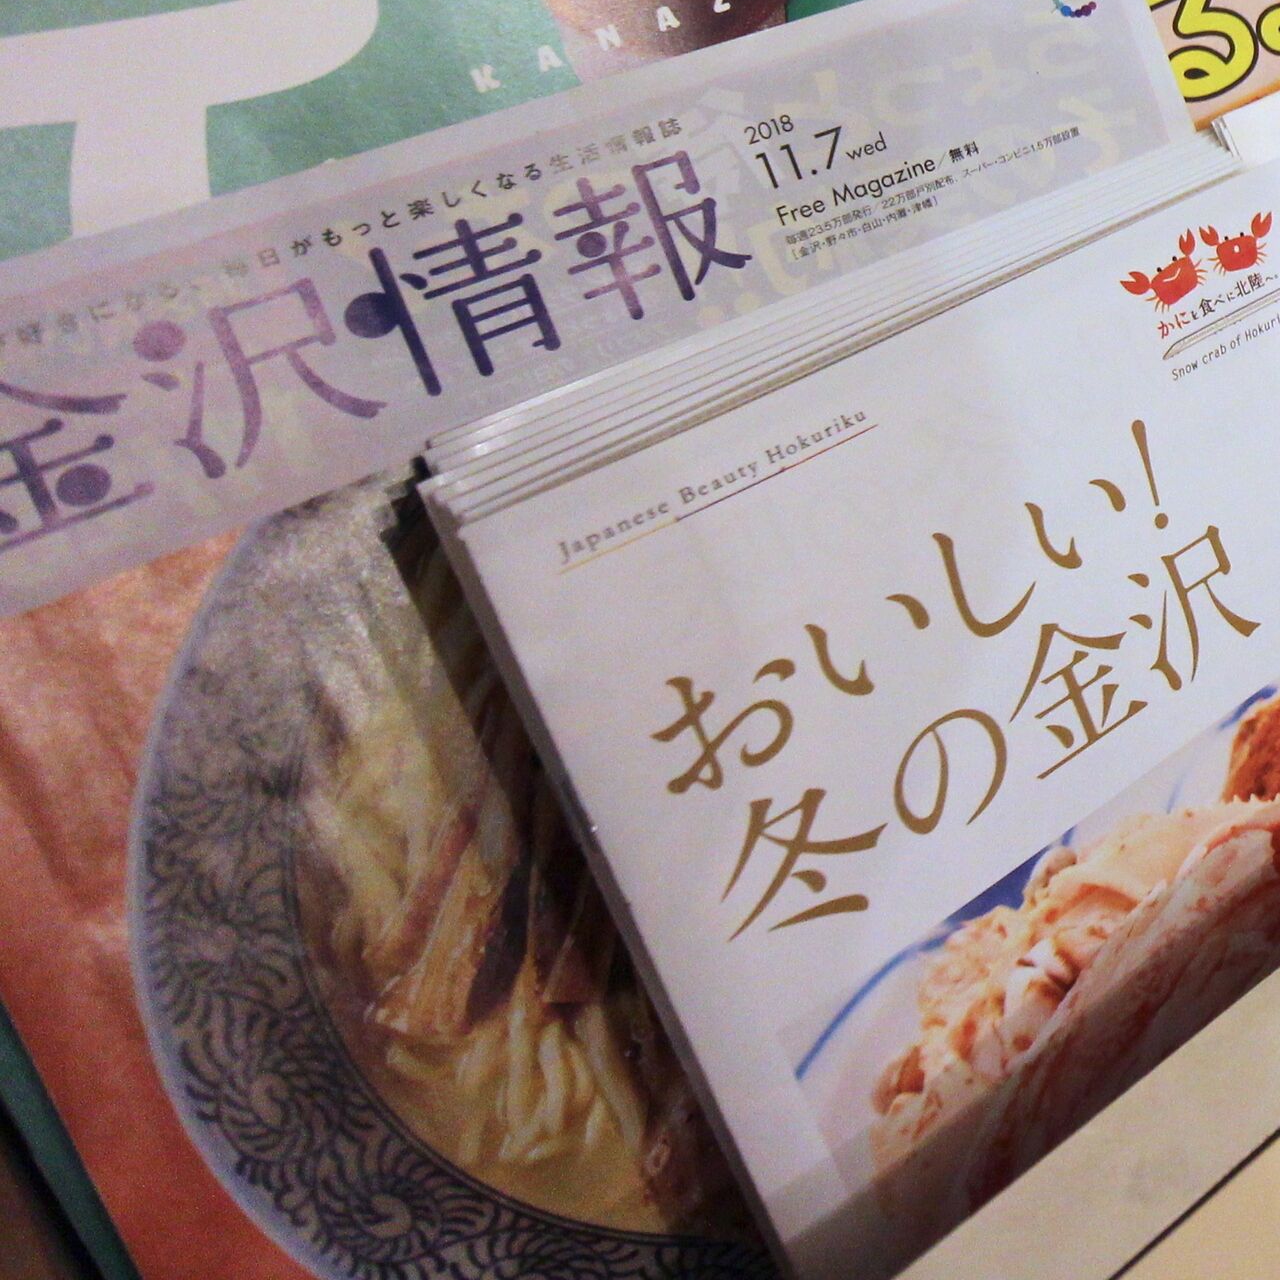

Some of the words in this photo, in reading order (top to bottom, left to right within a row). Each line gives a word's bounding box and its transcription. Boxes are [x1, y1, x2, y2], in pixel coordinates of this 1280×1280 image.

[744, 114, 795, 145] 2018
[776, 198, 827, 227] Free
[1171, 359, 1199, 382] Snow
[1202, 343, 1227, 365] crab
[1230, 333, 1242, 350] of
[557, 500, 670, 566] Japanese
[678, 460, 760, 506] Beauty
[764, 410, 868, 465] Hokuriku
[720, 524, 1263, 944] 冬の金沢
